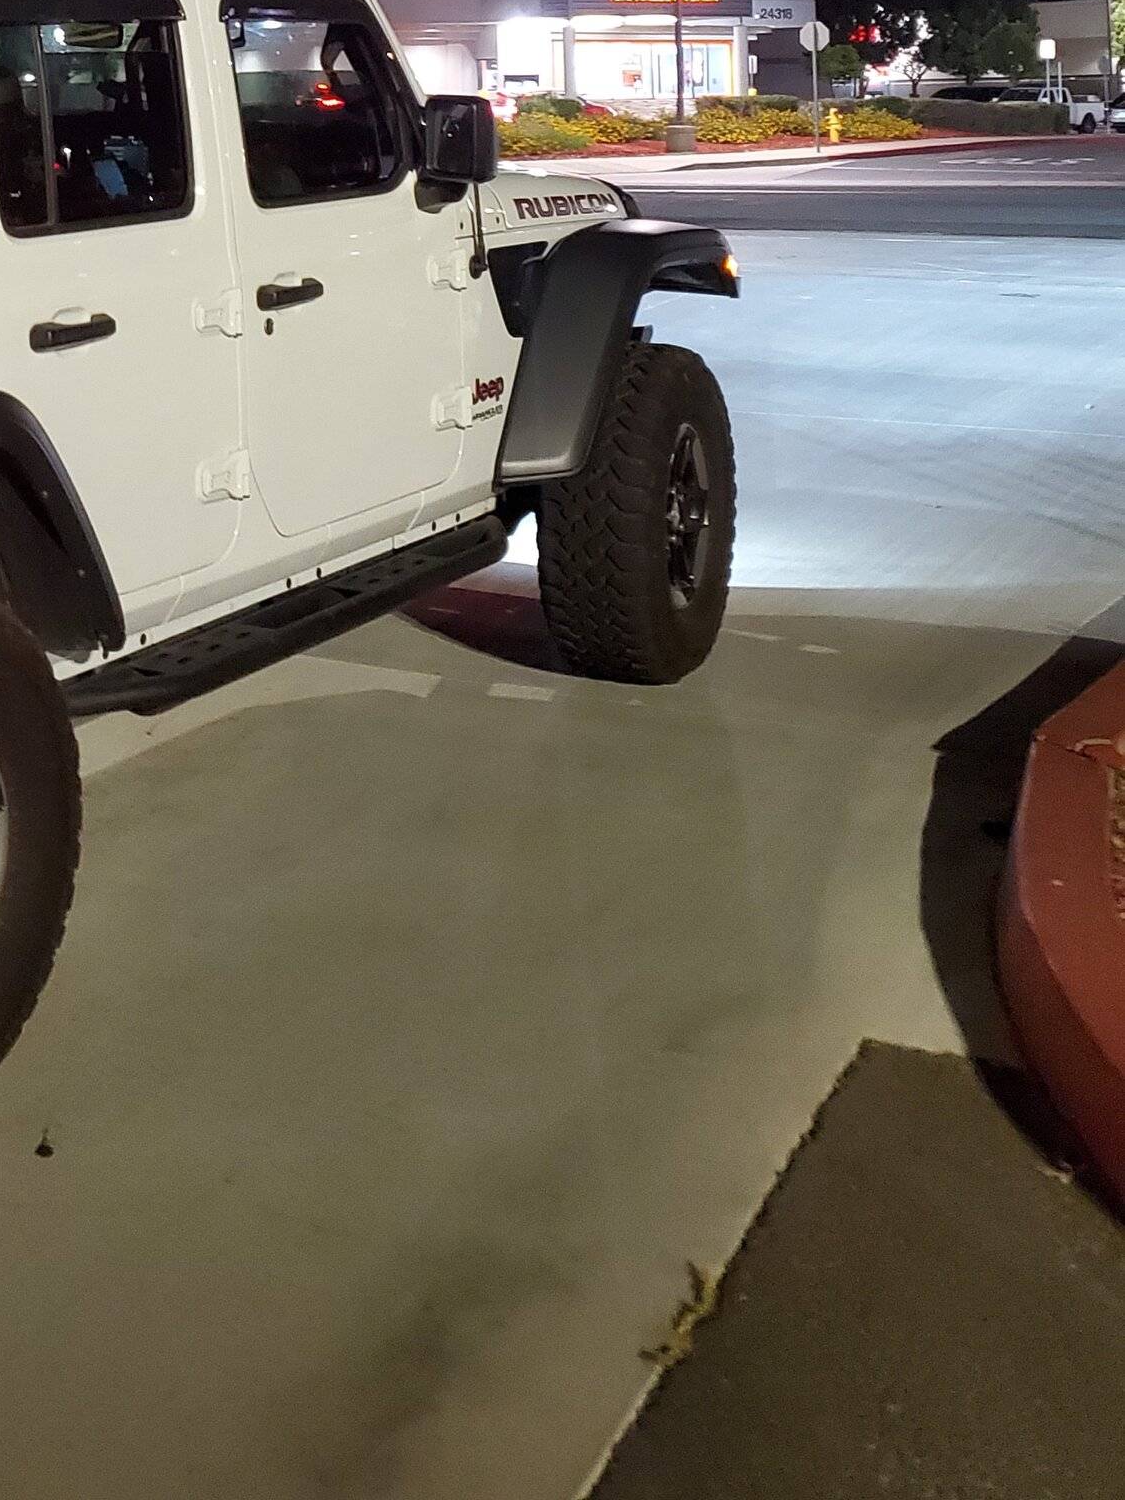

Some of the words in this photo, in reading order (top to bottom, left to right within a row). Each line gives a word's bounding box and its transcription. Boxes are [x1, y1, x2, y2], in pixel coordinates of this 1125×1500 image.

[759, 8, 793, 20] 24318
[513, 193, 618, 220] RUBICON
[472, 376, 504, 405] Jeep
